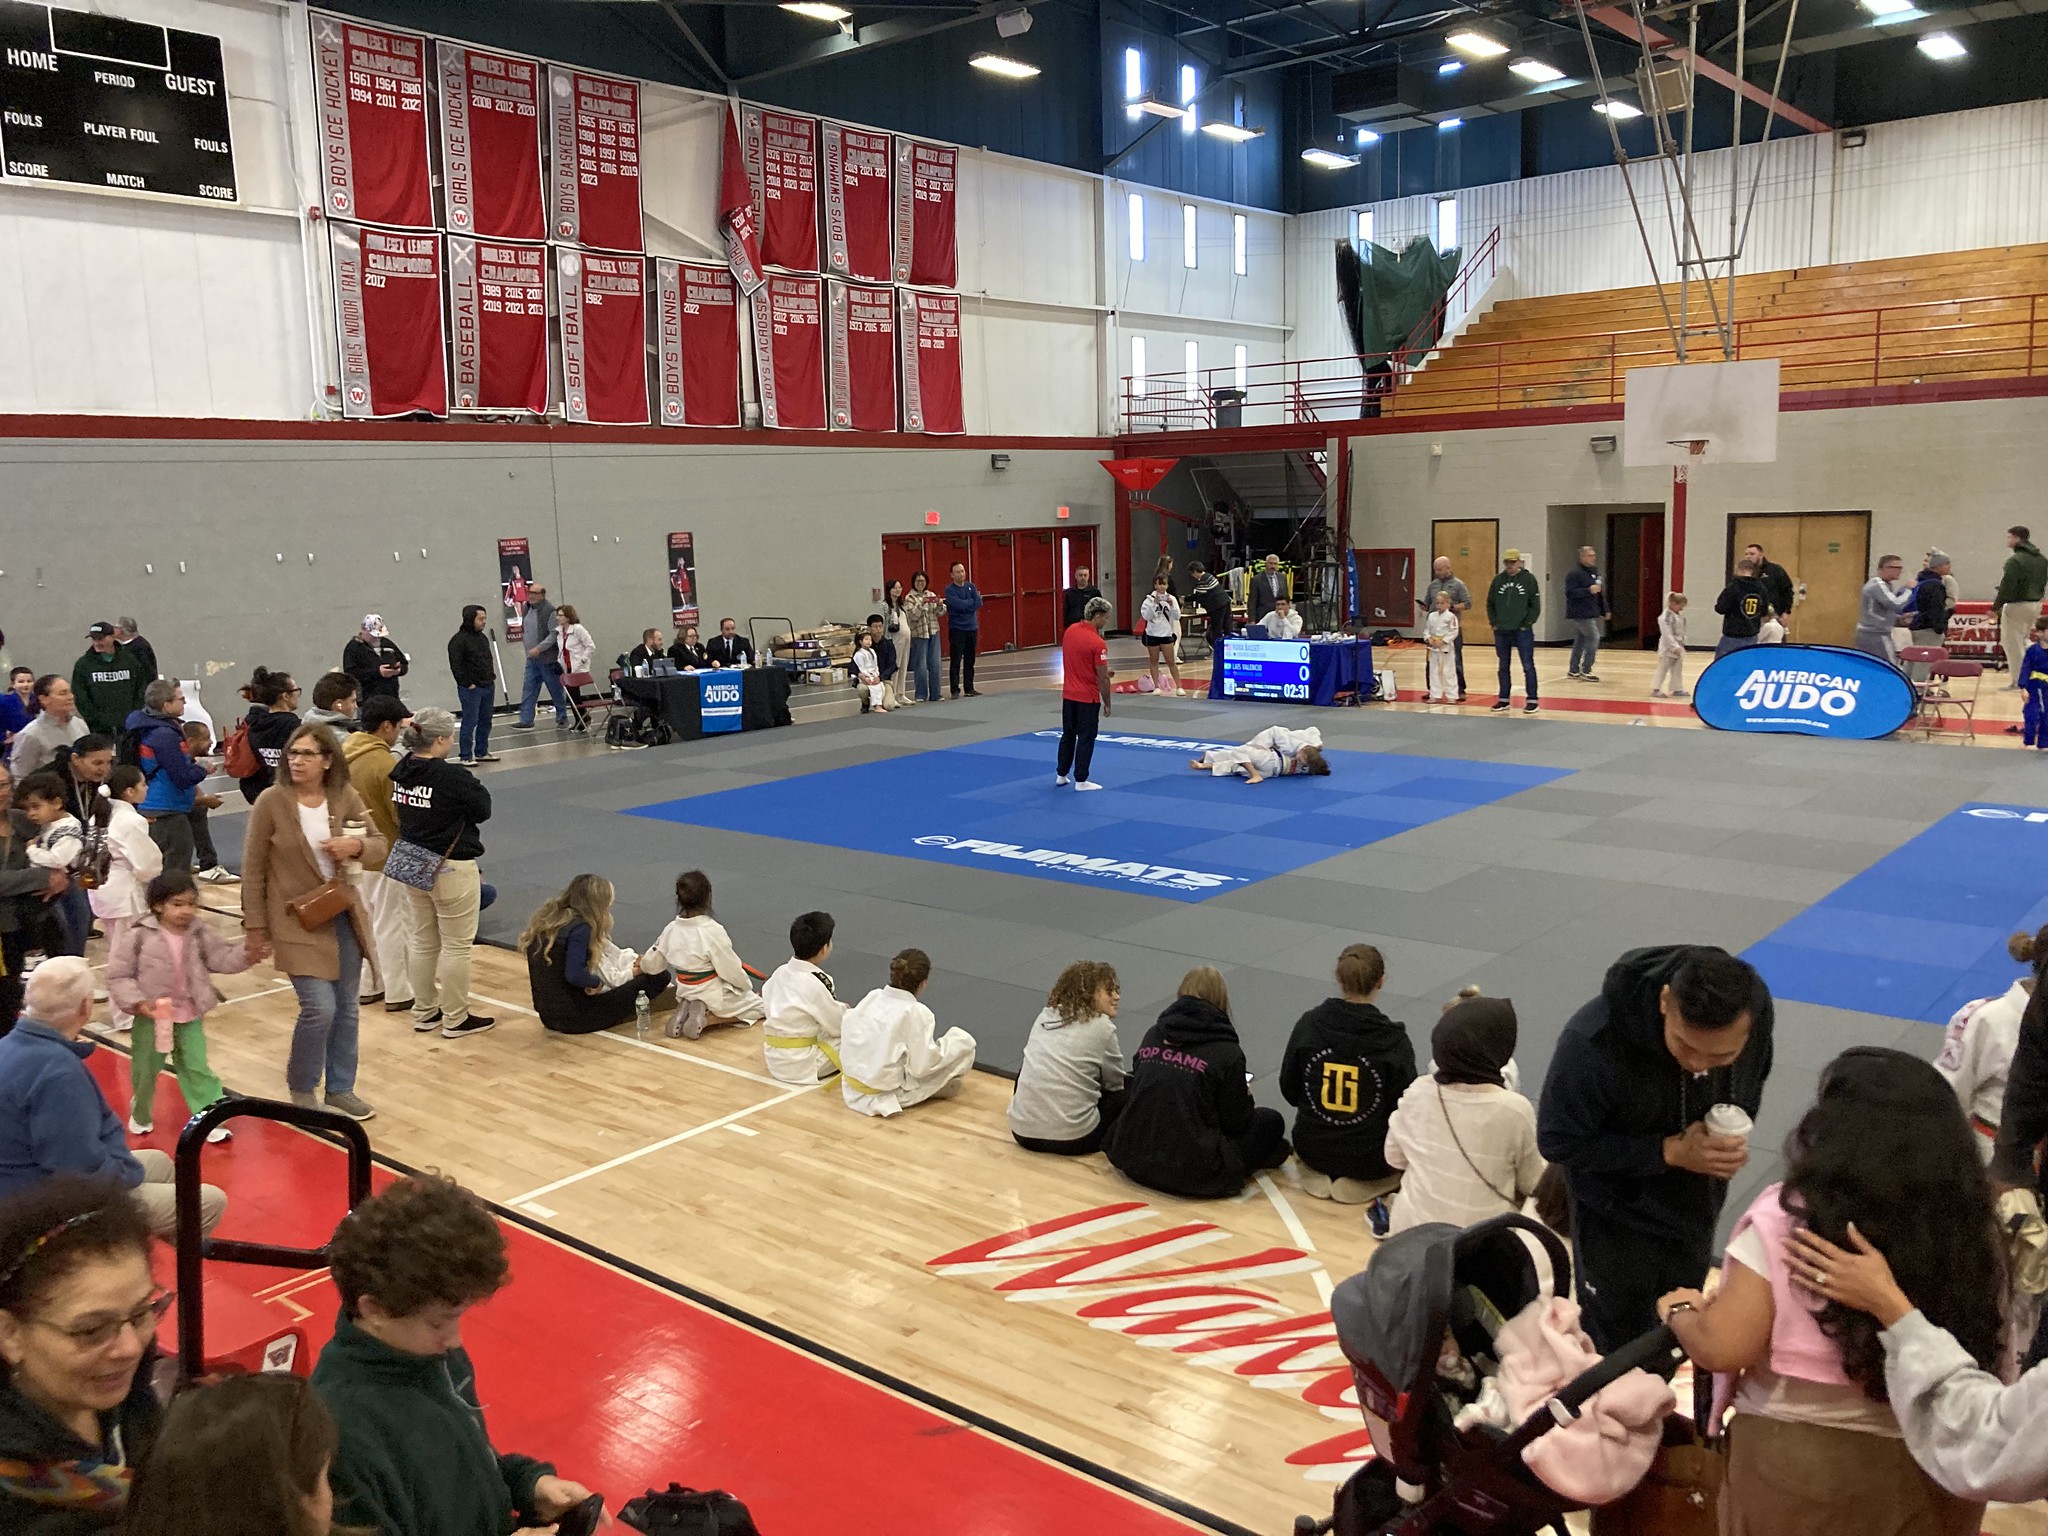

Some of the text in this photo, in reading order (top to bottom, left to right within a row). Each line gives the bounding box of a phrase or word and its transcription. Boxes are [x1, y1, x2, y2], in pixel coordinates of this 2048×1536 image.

[7, 48, 58, 72] HOME
[94, 71, 135, 88] PERIOD
[165, 73, 216, 97] GUEST
[349, 71, 371, 87] 1961
[375, 76, 397, 93] 1964
[350, 88, 372, 104] 1994
[376, 93, 397, 109] 2011
[4, 111, 43, 128] FOULS
[321, 45, 347, 187] BOYS ICE HOCKEY
[83, 121, 160, 144] PLAYER FOUL
[445, 69, 468, 205] GIRLS ICE HOCKEY
[194, 137, 229, 154] FOULS
[9, 161, 49, 177] SCORE
[557, 103, 575, 213] BOYS BASKETBALL
[106, 172, 145, 189] MATCH
[199, 184, 234, 200] SCORE
[827, 143, 843, 242] BOYS SWIMMING
[364, 273, 386, 289] 2017
[482, 284, 501, 297] 1989
[505, 286, 524, 299] 2015
[340, 259, 364, 374] GIRLS INDOOR TRACK
[483, 299, 502, 312] 2019
[505, 301, 525, 314] 2021
[458, 275, 475, 385] BASEBALL
[564, 284, 581, 388] SOFTBALL
[664, 289, 680, 395] BOYS TENNIS
[756, 296, 773, 400] BOYS LACROSSE
[1299, 645, 1309, 661] 0
[92, 669, 131, 682] FREEDOM
[1298, 665, 1310, 682] 0
[1734, 669, 1861, 697] AMERICAN
[704, 684, 739, 697] AMERICAN
[706, 690, 740, 703] JUDO
[1283, 683, 1310, 699] 02:31
[1739, 682, 1856, 717] JUDO
[943, 838, 1234, 888] FUJIMATS
[1050, 864, 1200, 891] FACILITY DESIGN
[1138, 1046, 1160, 1059] TOP
[1161, 1048, 1209, 1074] GAME
